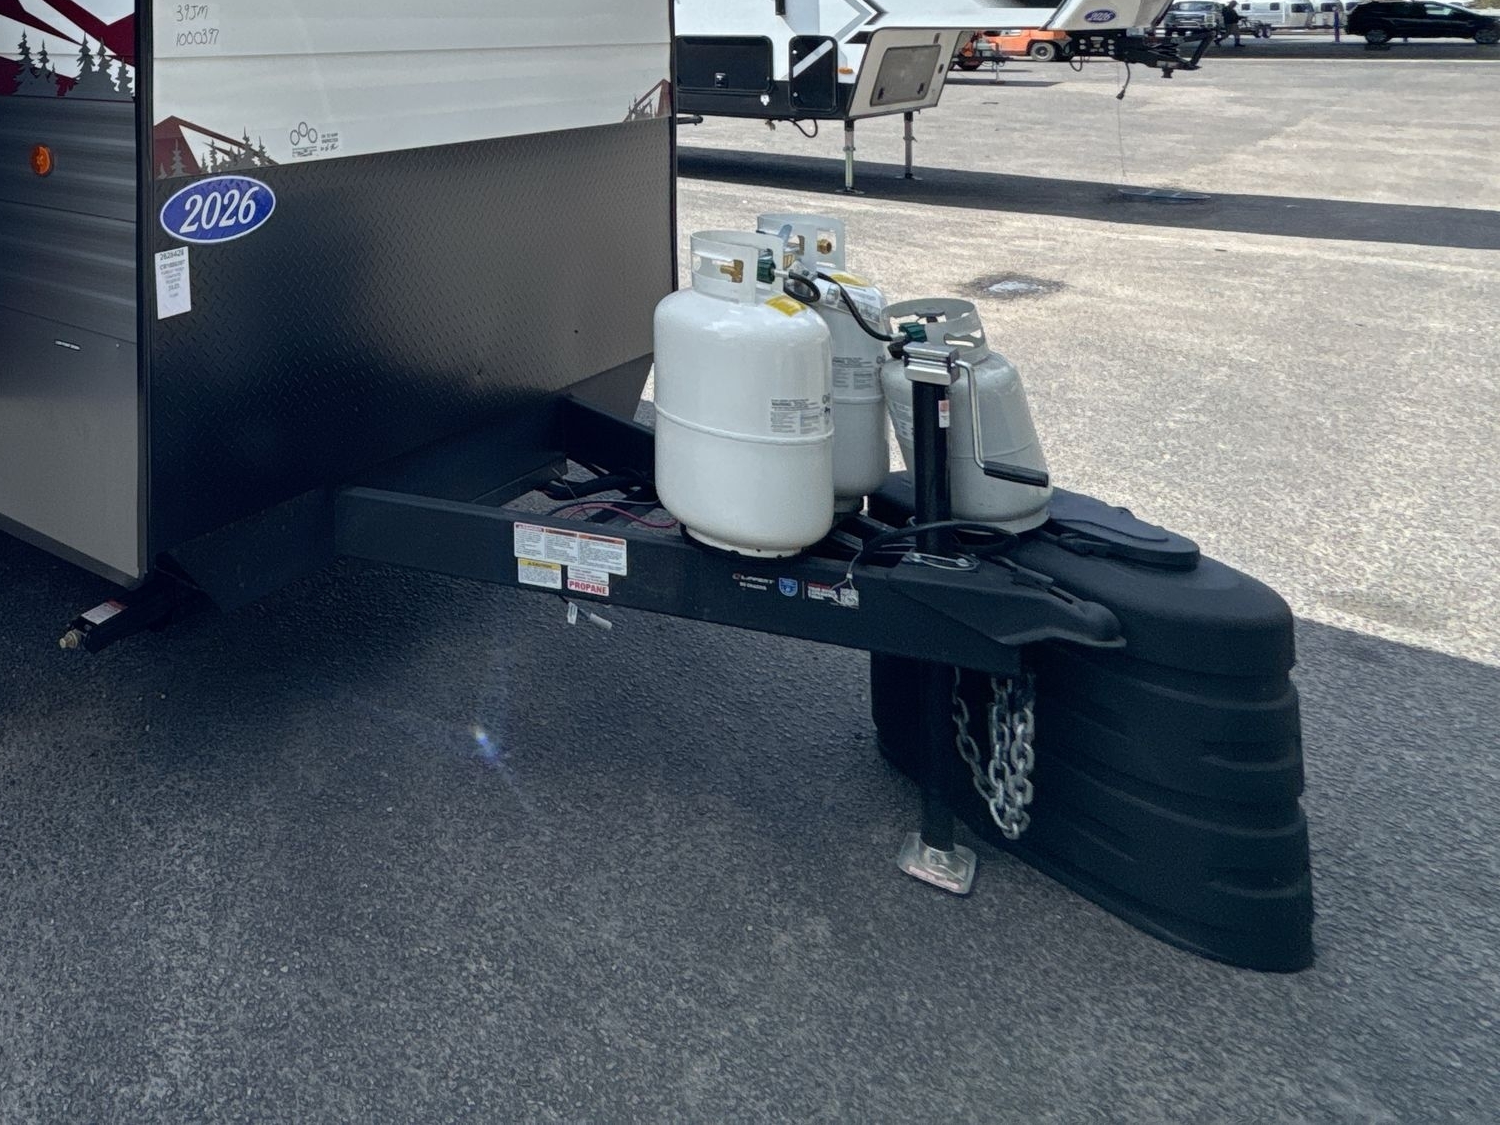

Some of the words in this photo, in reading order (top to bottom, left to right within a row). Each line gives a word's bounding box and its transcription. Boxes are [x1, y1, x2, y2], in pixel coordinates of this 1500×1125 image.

[175, 27, 220, 47] 1000397
[179, 186, 260, 233] 2026
[568, 580, 607, 595] PROPANE
